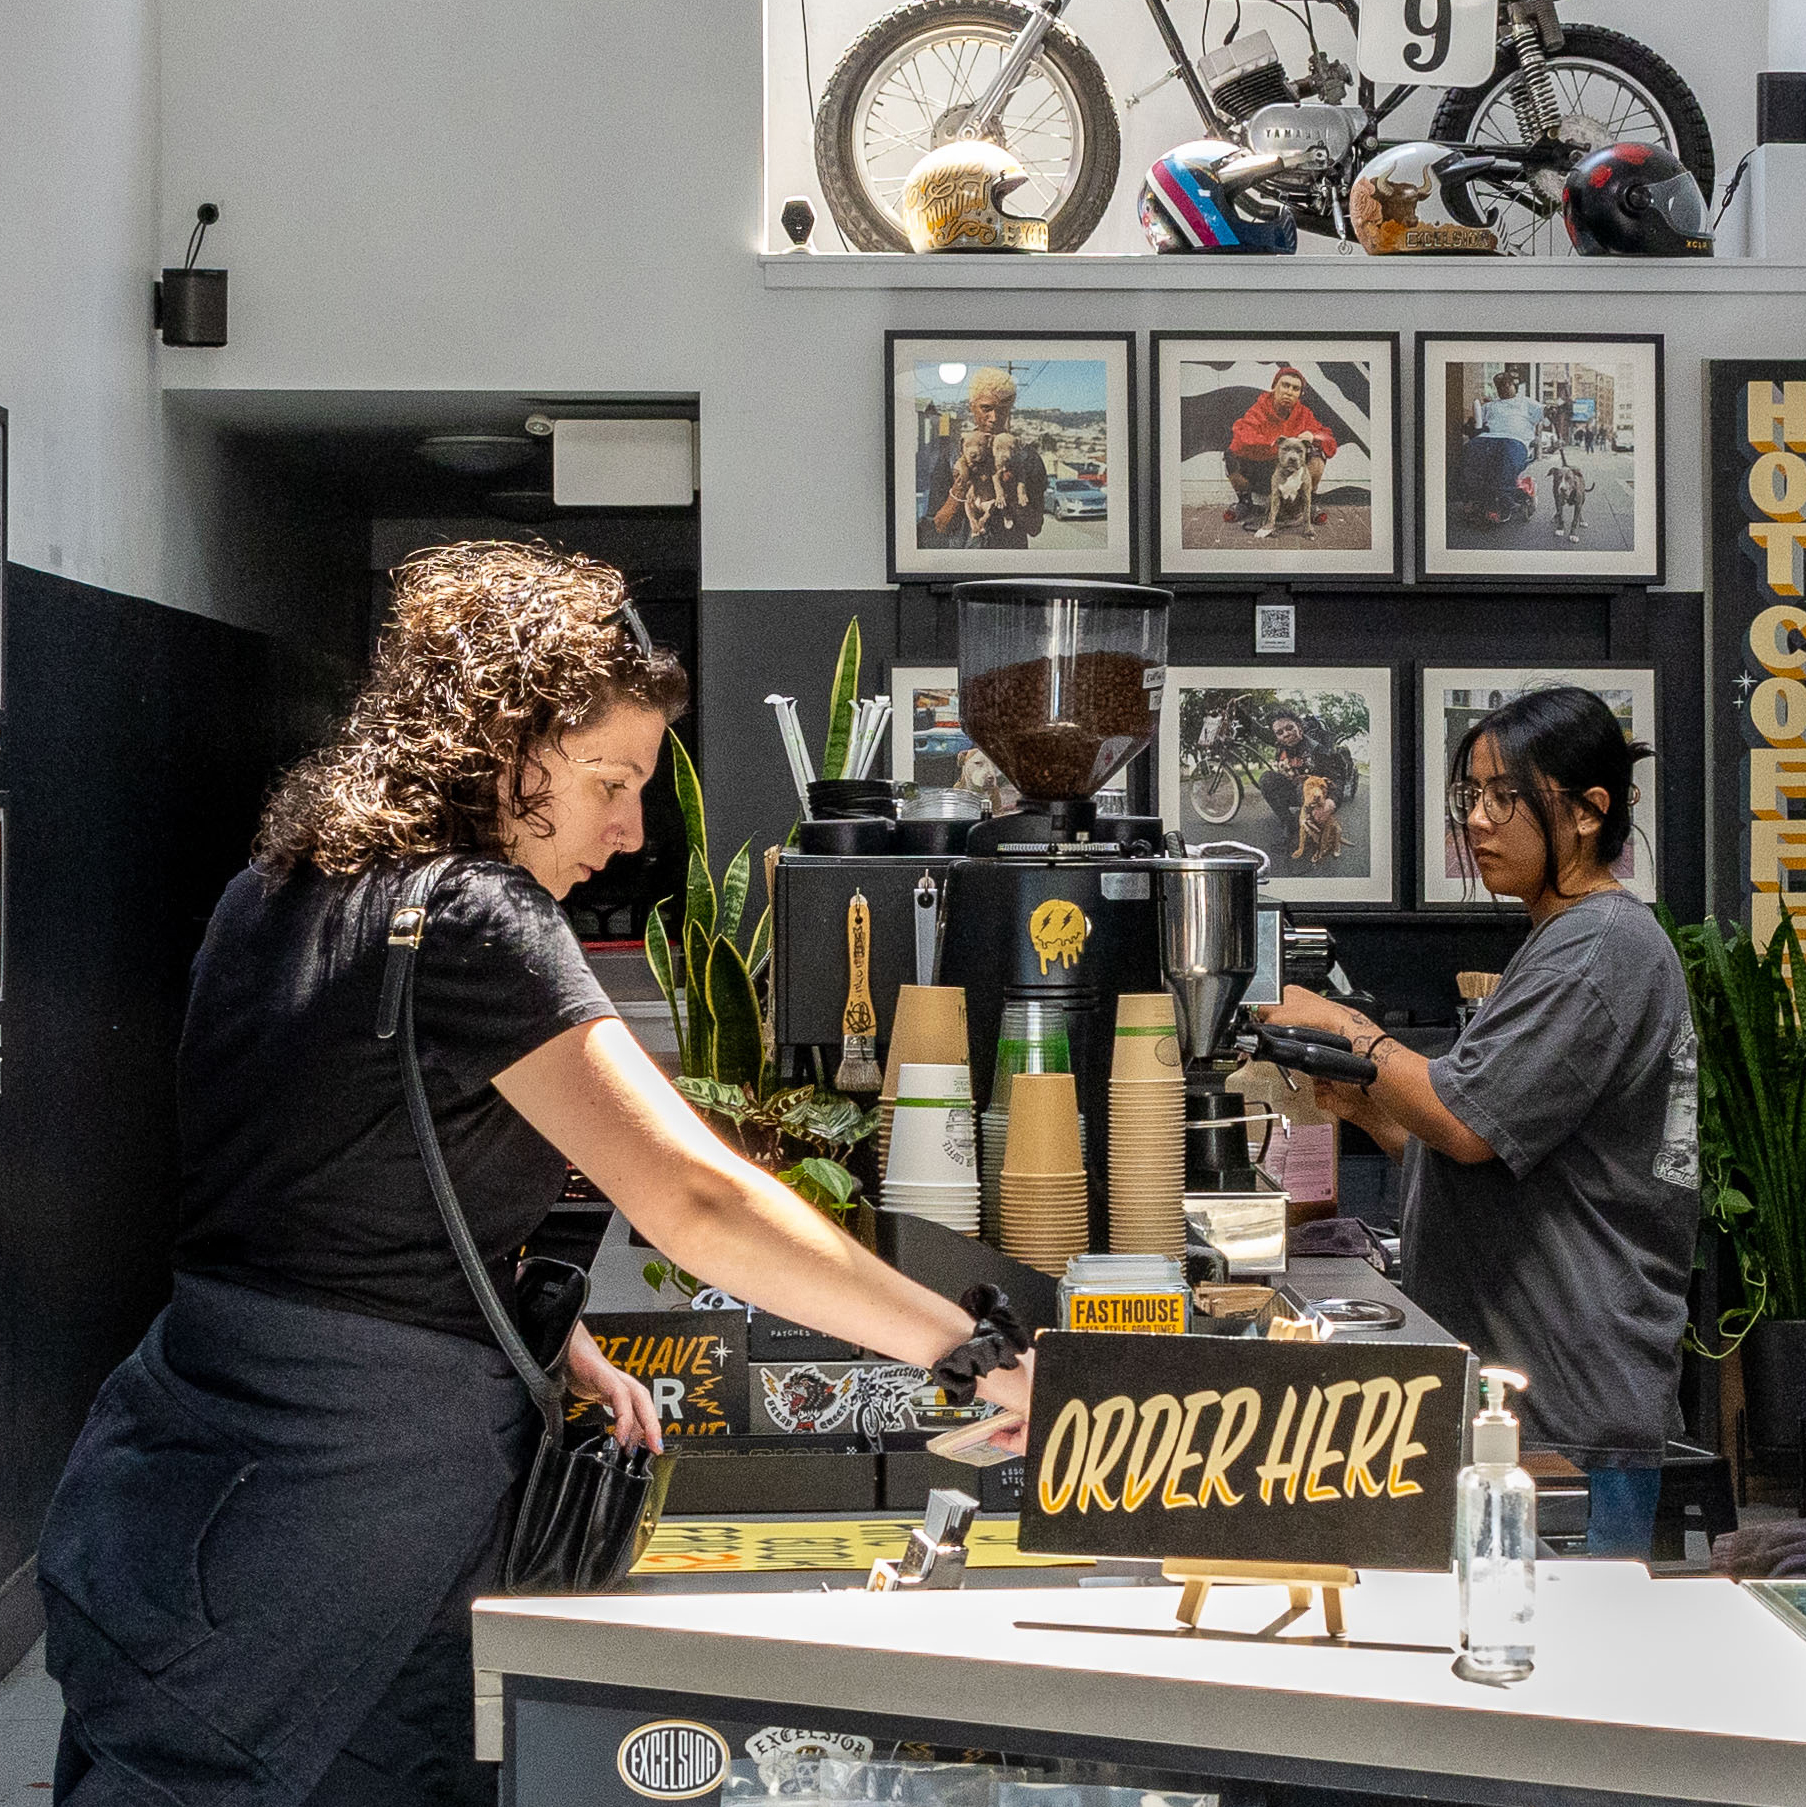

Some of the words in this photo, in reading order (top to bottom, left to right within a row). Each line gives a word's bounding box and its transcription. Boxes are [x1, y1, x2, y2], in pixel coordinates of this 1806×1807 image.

[1406, 230, 1490, 248] EXCELSIOR
[1075, 1298, 1180, 1324] FASTHOUSE
[770, 1329, 812, 1338] PATCHES
[1037, 1386, 1262, 1516] ORDER
[1255, 1374, 1443, 1506] HERE
[753, 1727, 866, 1757] EXCELSIOR
[630, 1730, 717, 1790] EXCELSIOR
